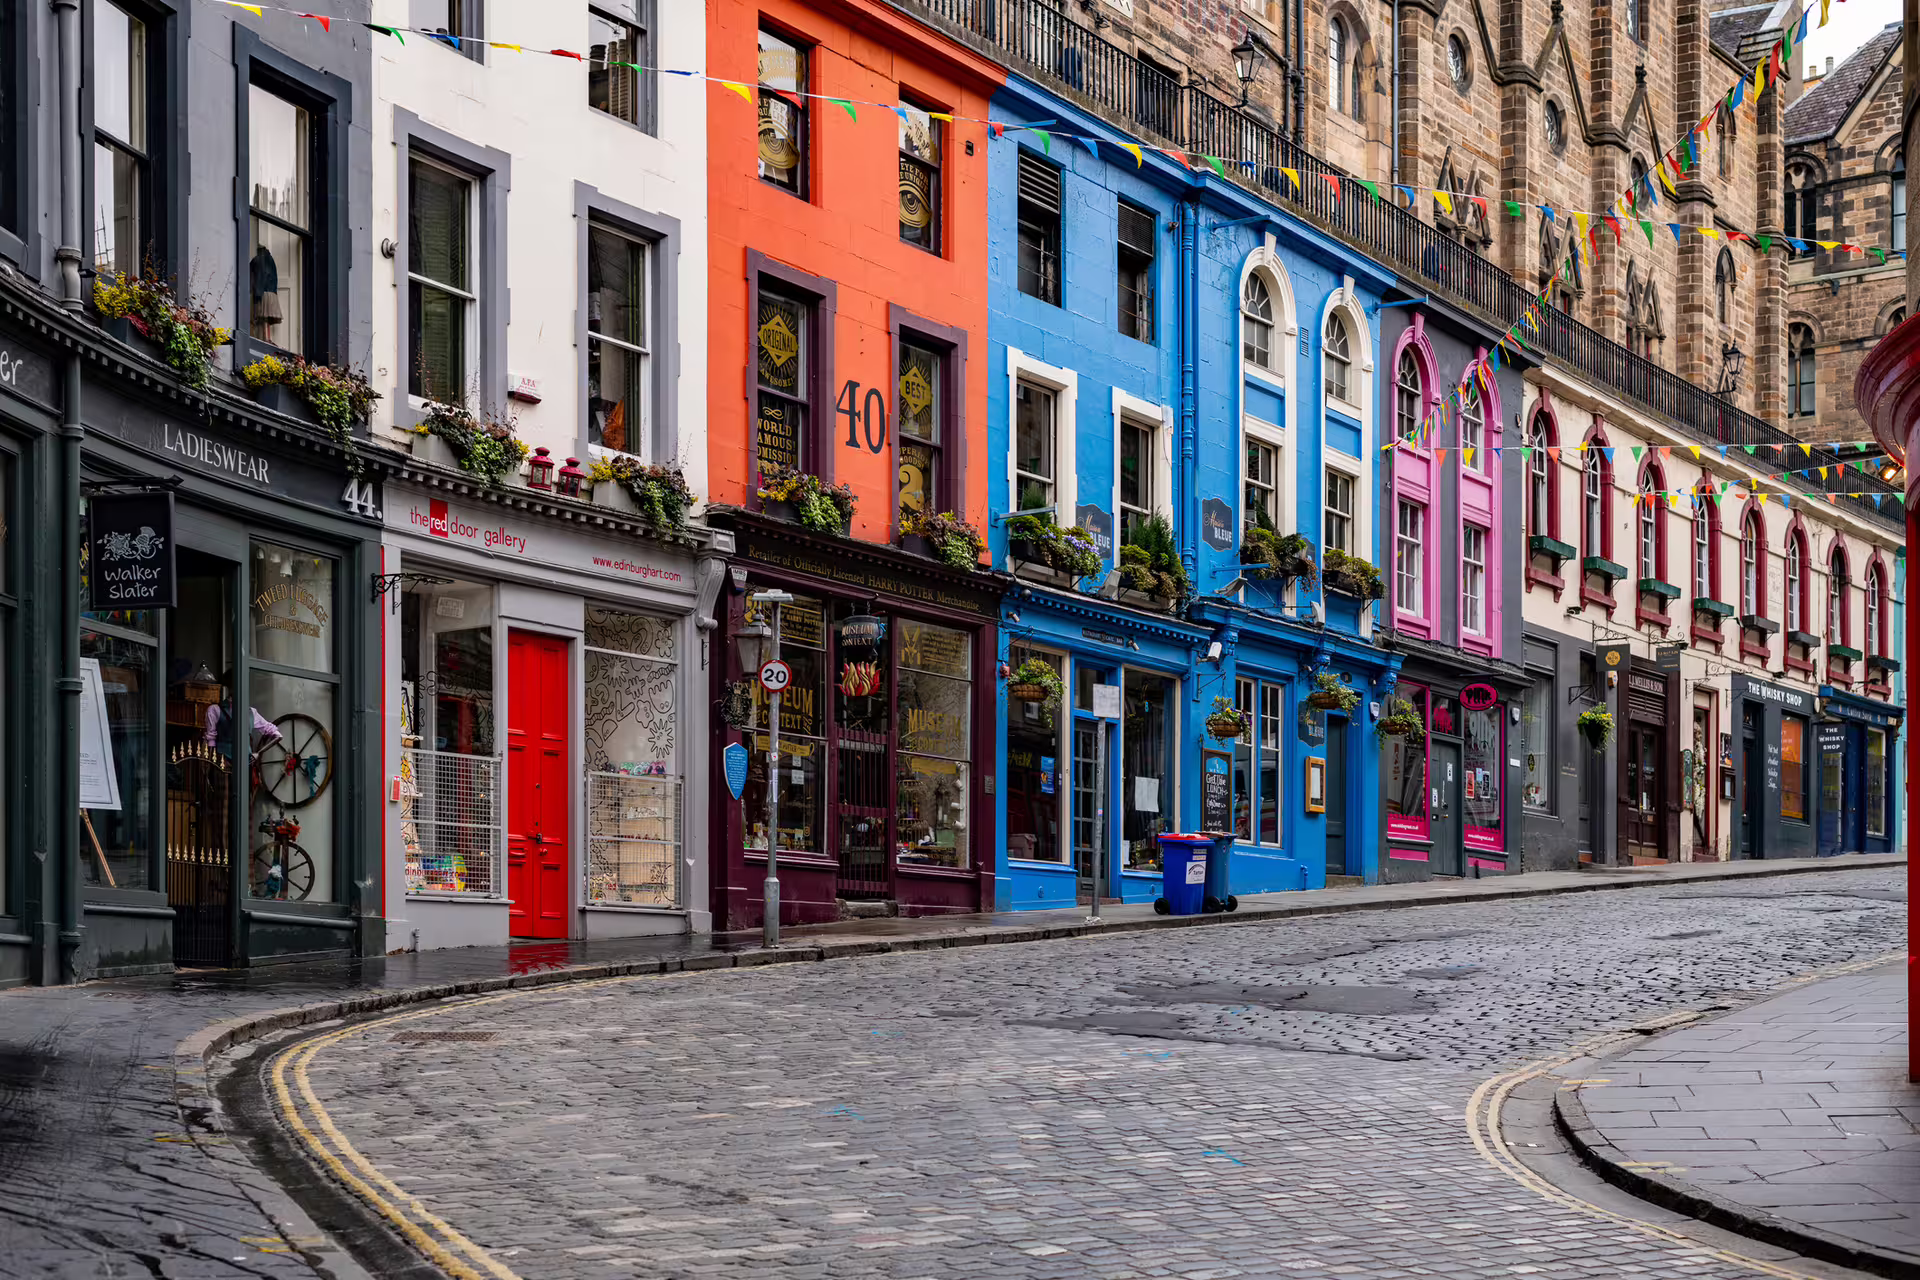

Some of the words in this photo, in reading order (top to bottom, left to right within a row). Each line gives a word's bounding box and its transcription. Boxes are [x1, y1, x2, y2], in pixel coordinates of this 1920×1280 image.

[763, 329, 794, 353] ORIGINAL
[905, 380, 926, 400] BEST
[836, 379, 885, 454] 40
[164, 423, 270, 484] LADIESWEAR
[410, 505, 429, 527] the
[430, 511, 448, 531] red
[451, 515, 478, 539] door
[484, 527, 526, 553] gallery
[1214, 526, 1232, 543] BLEUE
[592, 555, 682, 582] www.edinburghart.com
[748, 544, 780, 563] Retailer
[782, 555, 792, 566] of
[794, 557, 831, 579] Officially
[833, 566, 865, 584] Licensed
[868, 575, 898, 591] HARRY
[900, 583, 934, 600] POTTER
[256, 583, 288, 612] TWEED
[841, 624, 873, 636] MUSEUM
[763, 668, 787, 684] 20
[751, 680, 813, 717] MUEUM
[1748, 681, 1760, 695] THE
[1760, 682, 1785, 703] WHISKY
[1786, 692, 1802, 706] SHOP
[761, 709, 801, 729] CTEXT
